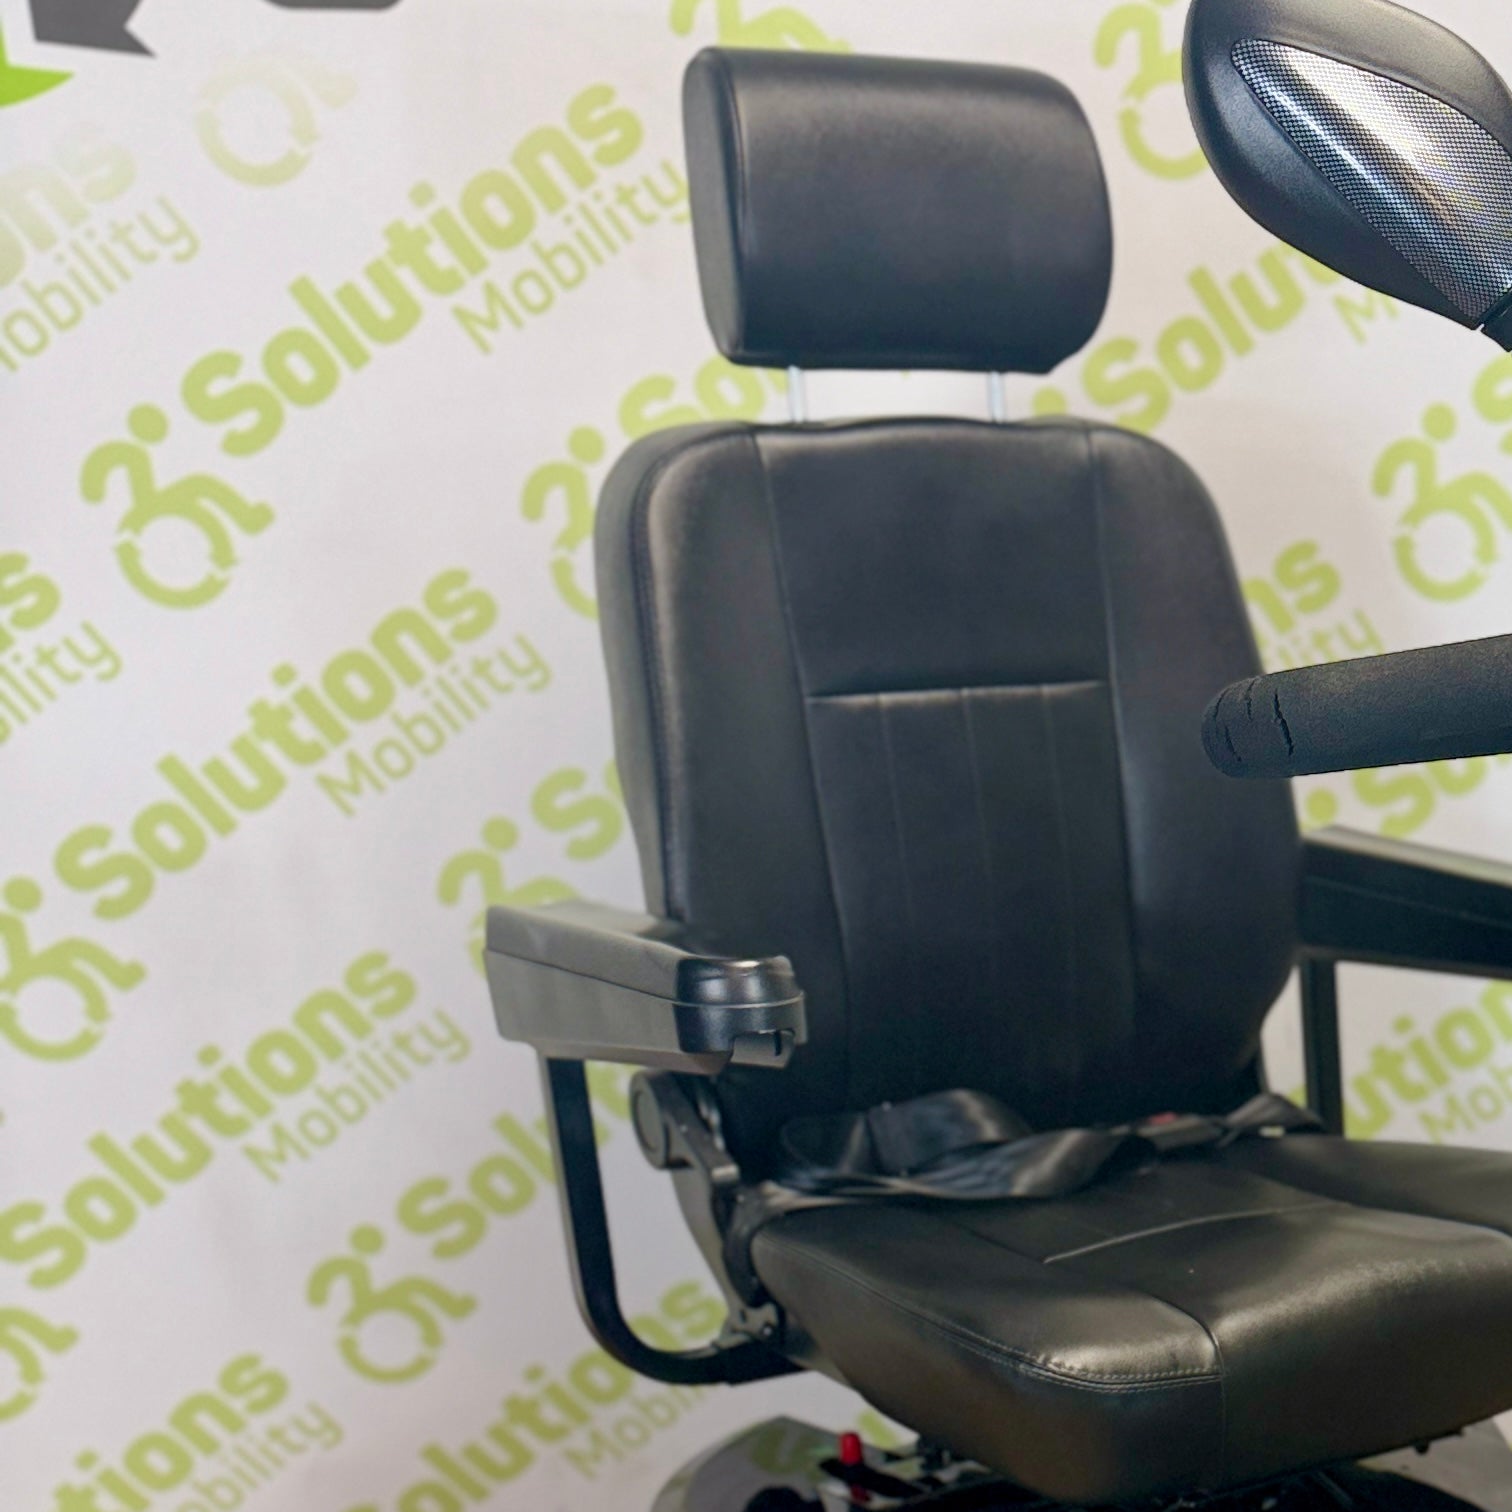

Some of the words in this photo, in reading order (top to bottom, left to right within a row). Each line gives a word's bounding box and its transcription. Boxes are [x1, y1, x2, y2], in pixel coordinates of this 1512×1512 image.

[0, 196, 200, 373] obility
[179, 82, 643, 457] Solutions
[450, 160, 690, 355] Mobility
[0, 620, 124, 748] ility
[53, 567, 498, 921] Solutions
[316, 634, 553, 818] Mobility
[0, 950, 417, 1290] Solutions
[242, 1008, 472, 1184] Mobility
